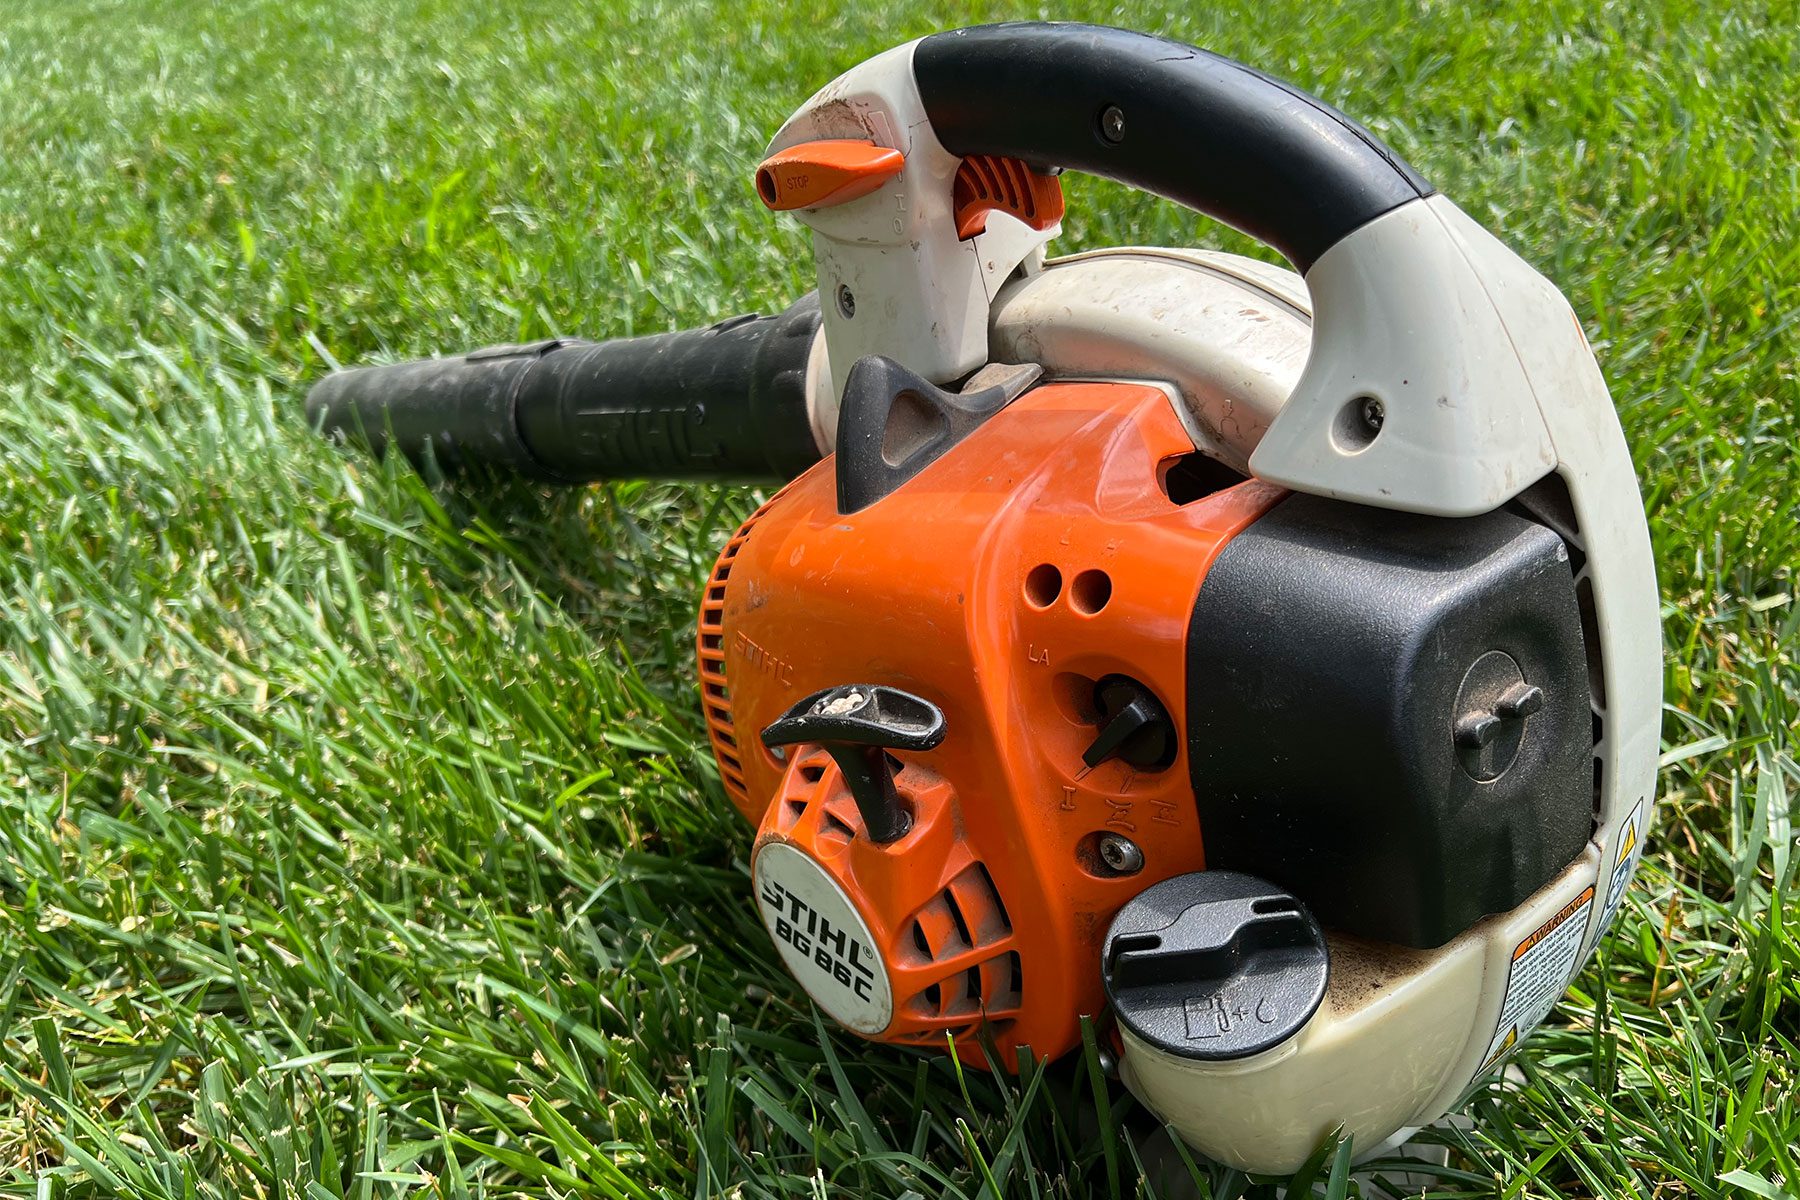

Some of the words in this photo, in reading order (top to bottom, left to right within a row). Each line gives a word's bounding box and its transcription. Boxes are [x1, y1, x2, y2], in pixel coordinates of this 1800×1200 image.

[786, 175, 809, 190] STOP
[735, 630, 793, 687] STIHL
[1028, 643, 1050, 666] LA
[1536, 895, 1584, 941] WARNING
